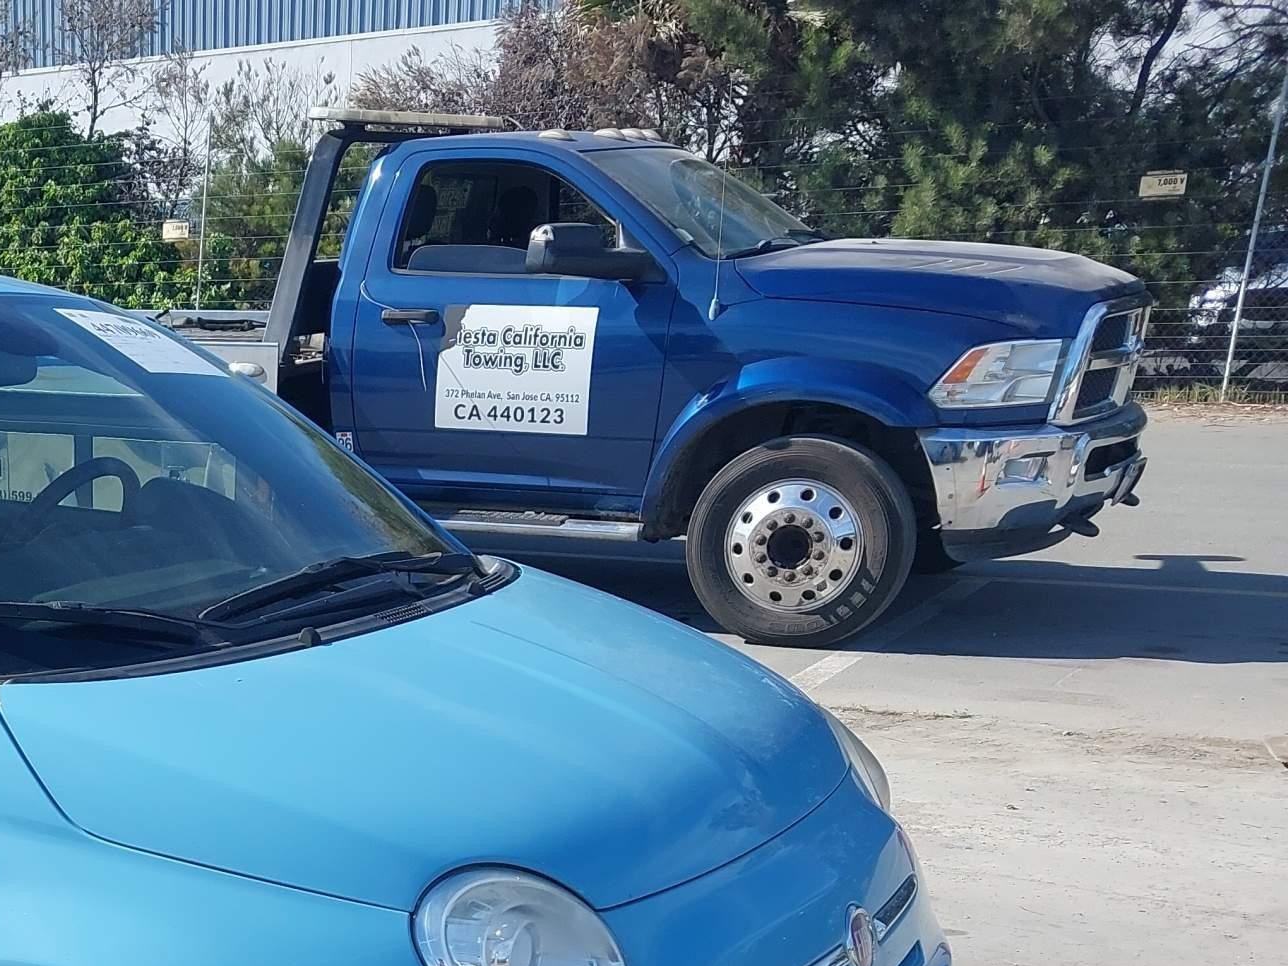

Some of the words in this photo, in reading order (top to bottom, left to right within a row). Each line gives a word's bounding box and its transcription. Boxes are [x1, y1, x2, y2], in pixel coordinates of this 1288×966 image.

[1158, 178, 1177, 187] 7,000
[456, 327, 498, 347] iesta
[502, 326, 585, 348] California
[464, 348, 529, 374] Towing,
[533, 350, 566, 371] LLC.
[445, 389, 460, 399] 372
[461, 390, 486, 400] Phelan
[506, 392, 520, 401] San
[522, 392, 539, 402] Jose
[555, 393, 580, 404] 95112
[454, 403, 482, 421] CA
[486, 404, 565, 425] 440123
